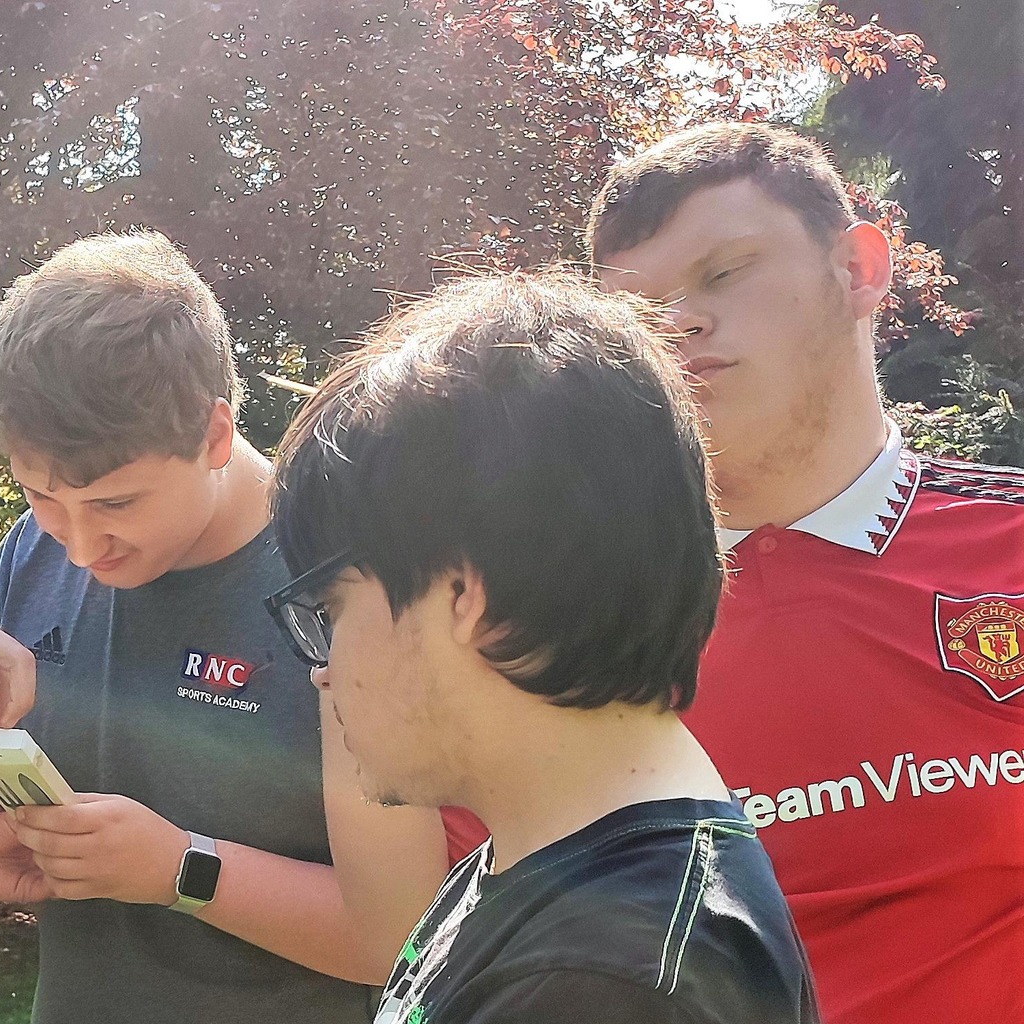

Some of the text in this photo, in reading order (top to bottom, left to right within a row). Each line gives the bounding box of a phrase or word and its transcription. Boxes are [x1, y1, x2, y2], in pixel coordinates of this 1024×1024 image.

[184, 652, 246, 687] RNC
[177, 686, 261, 713] SPORTS ACADEMY
